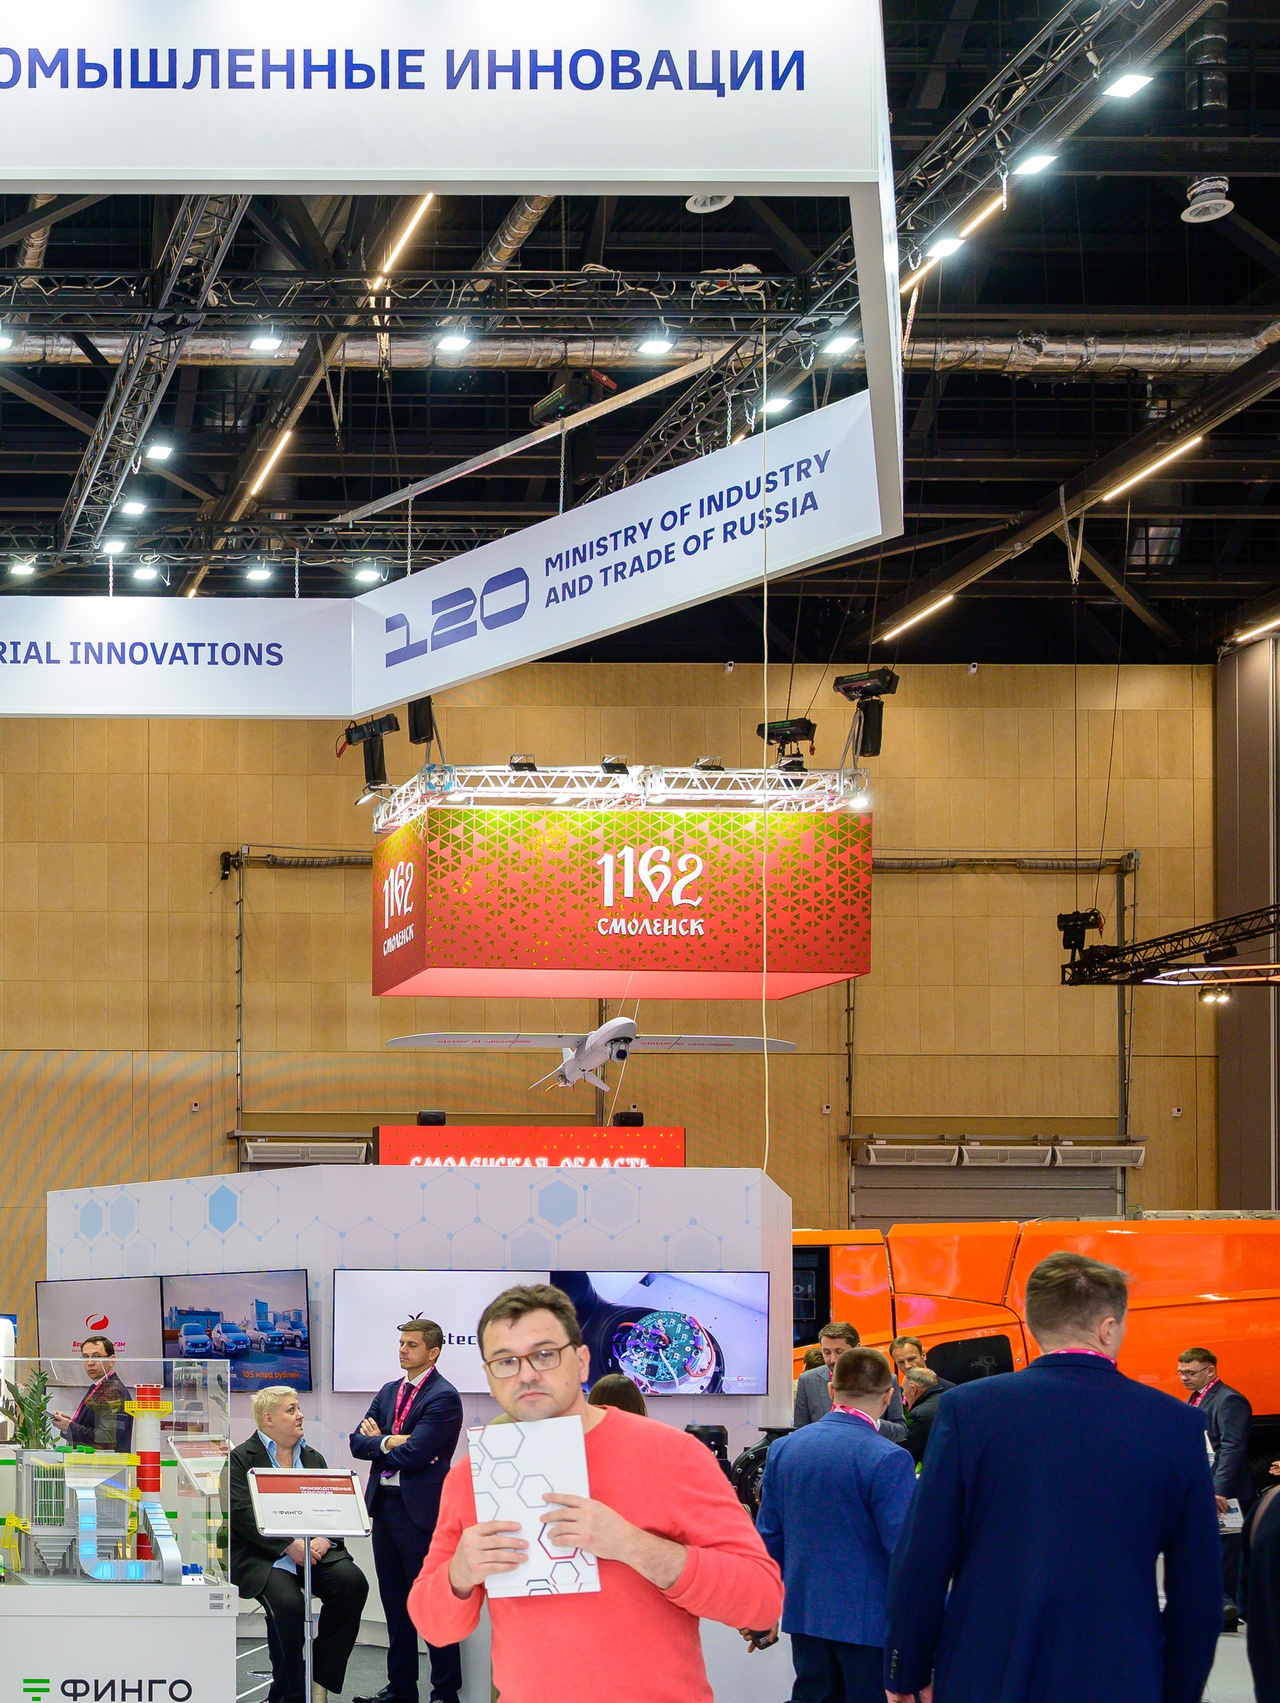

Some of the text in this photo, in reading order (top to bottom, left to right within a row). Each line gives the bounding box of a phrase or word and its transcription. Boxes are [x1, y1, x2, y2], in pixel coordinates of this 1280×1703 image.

[445, 48, 805, 98] ИННОВАЦИИ
[545, 449, 832, 577] MINISTRY OF INDUSTRY
[545, 490, 819, 609] AND TRADE OF RUSSIA
[385, 566, 530, 669] 120
[69, 641, 284, 667] INNOVATIONS
[382, 860, 415, 930] 1162
[596, 845, 704, 908] 1162
[382, 923, 415, 957] СМОЛЕНСК
[596, 917, 705, 937] СМОЛЕНСК
[255, 1372, 274, 1380] млрд
[274, 1370, 299, 1380] рублей
[60, 1678, 193, 1703] ФИНГО
